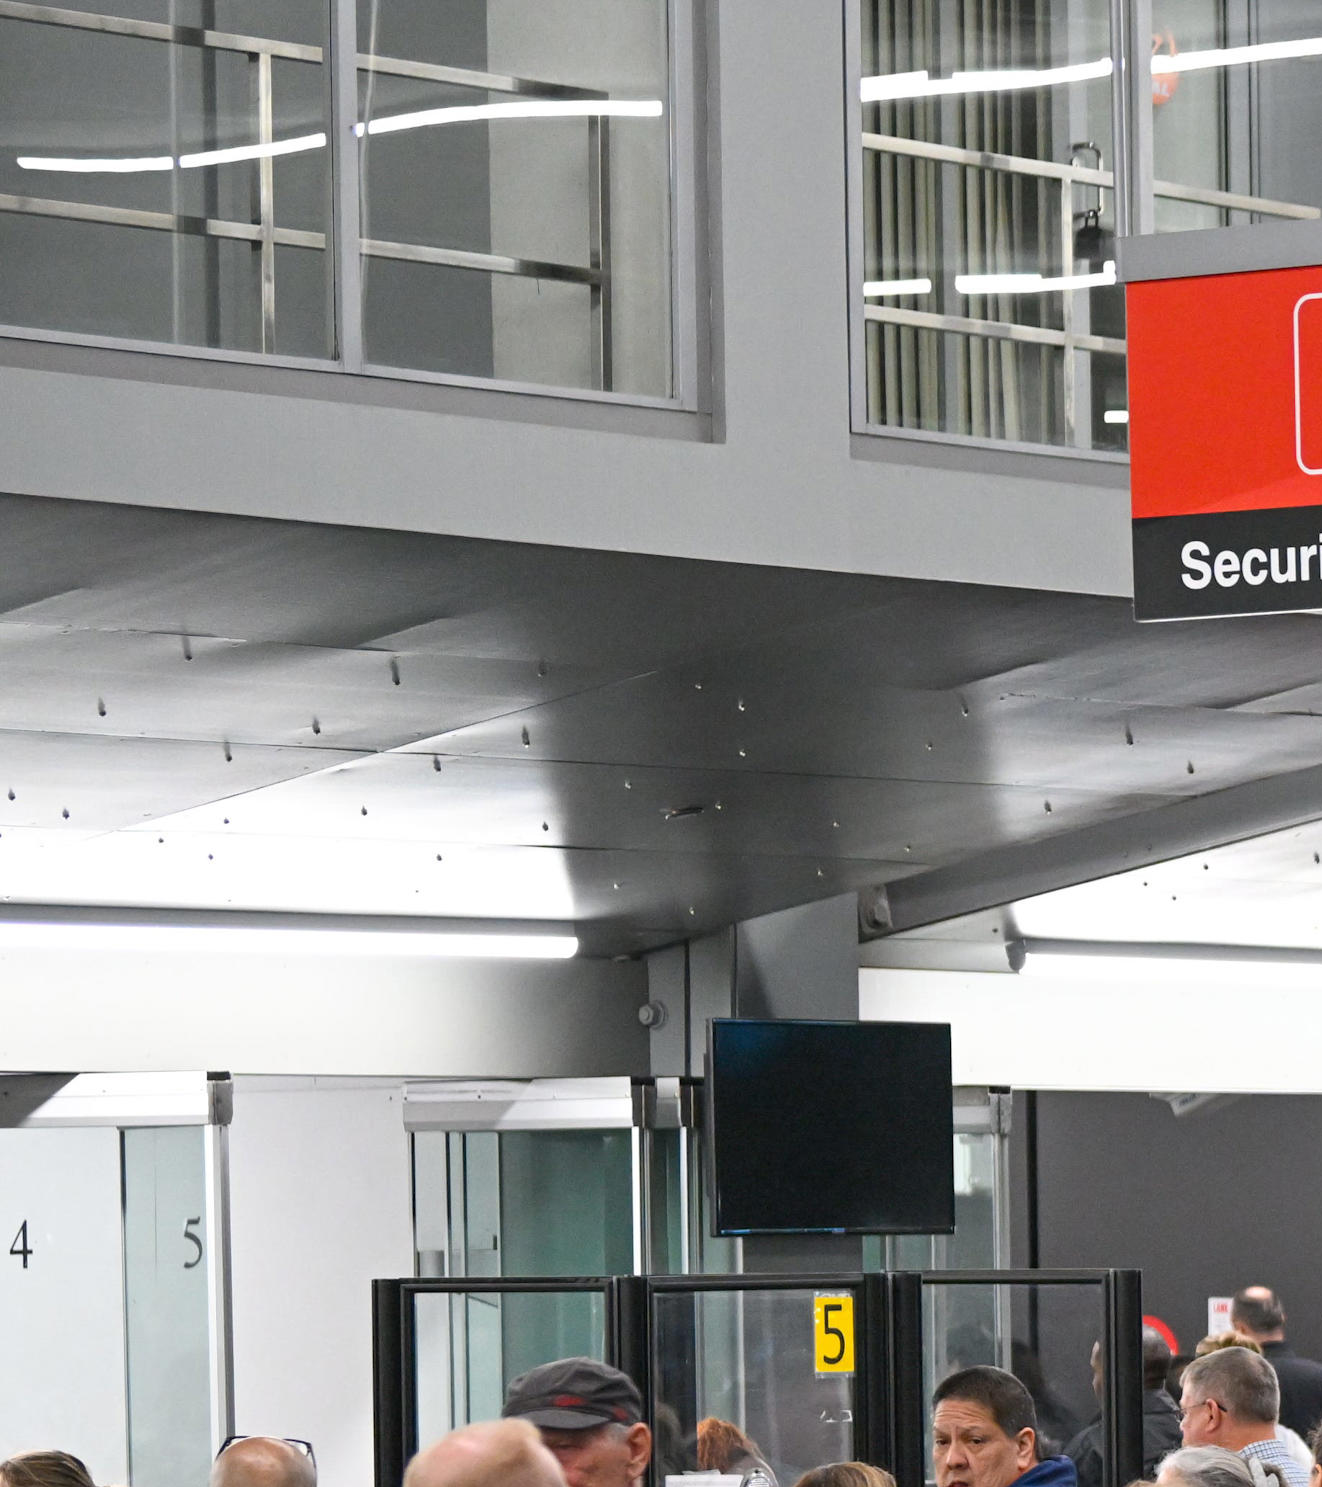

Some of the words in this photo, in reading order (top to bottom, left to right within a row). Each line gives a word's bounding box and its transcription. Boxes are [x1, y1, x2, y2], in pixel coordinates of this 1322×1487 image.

[9, 1219, 33, 1269] 4
[183, 1216, 203, 1269] 5
[823, 1304, 846, 1364] 5
